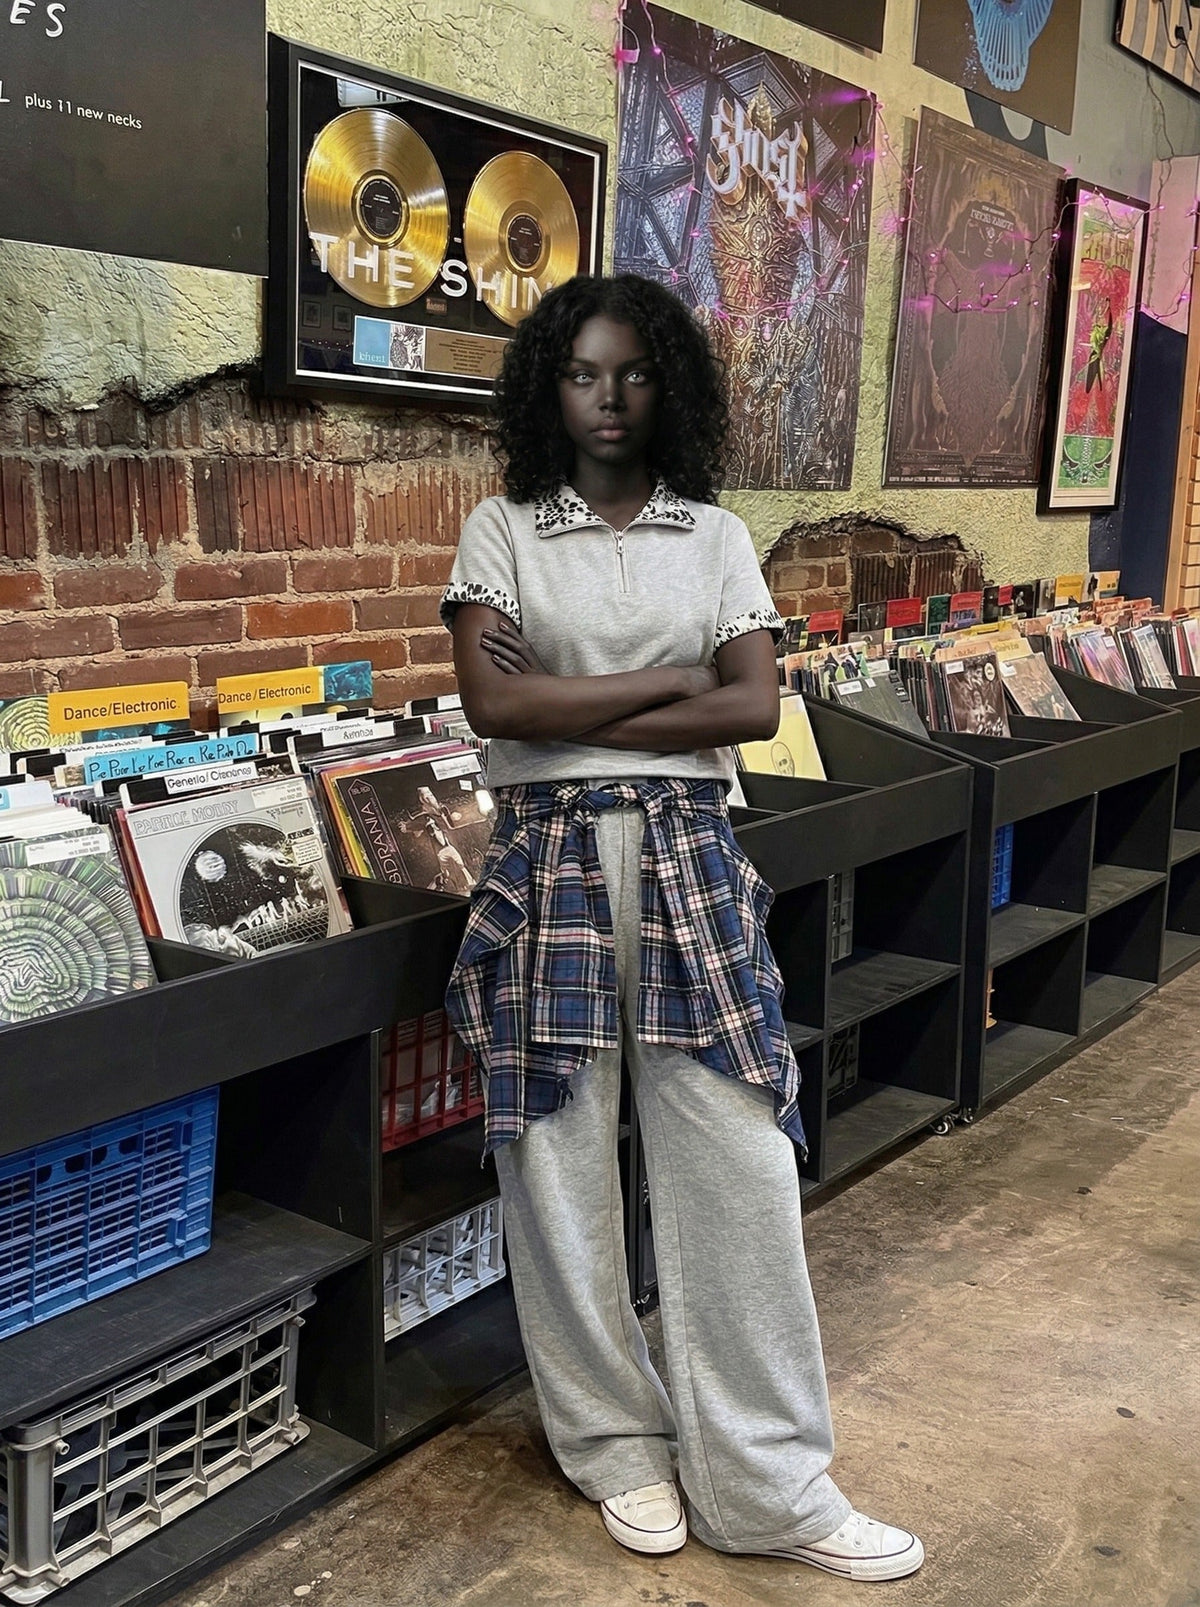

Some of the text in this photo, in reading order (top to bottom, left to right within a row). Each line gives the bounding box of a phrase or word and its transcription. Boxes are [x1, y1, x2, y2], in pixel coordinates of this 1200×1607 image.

[25, 92, 52, 109] plus
[58, 99, 71, 114] 11
[77, 106, 104, 120] new
[107, 113, 142, 129] necks
[308, 231, 416, 291] THE
[63, 697, 177, 721] Dance/Electronic
